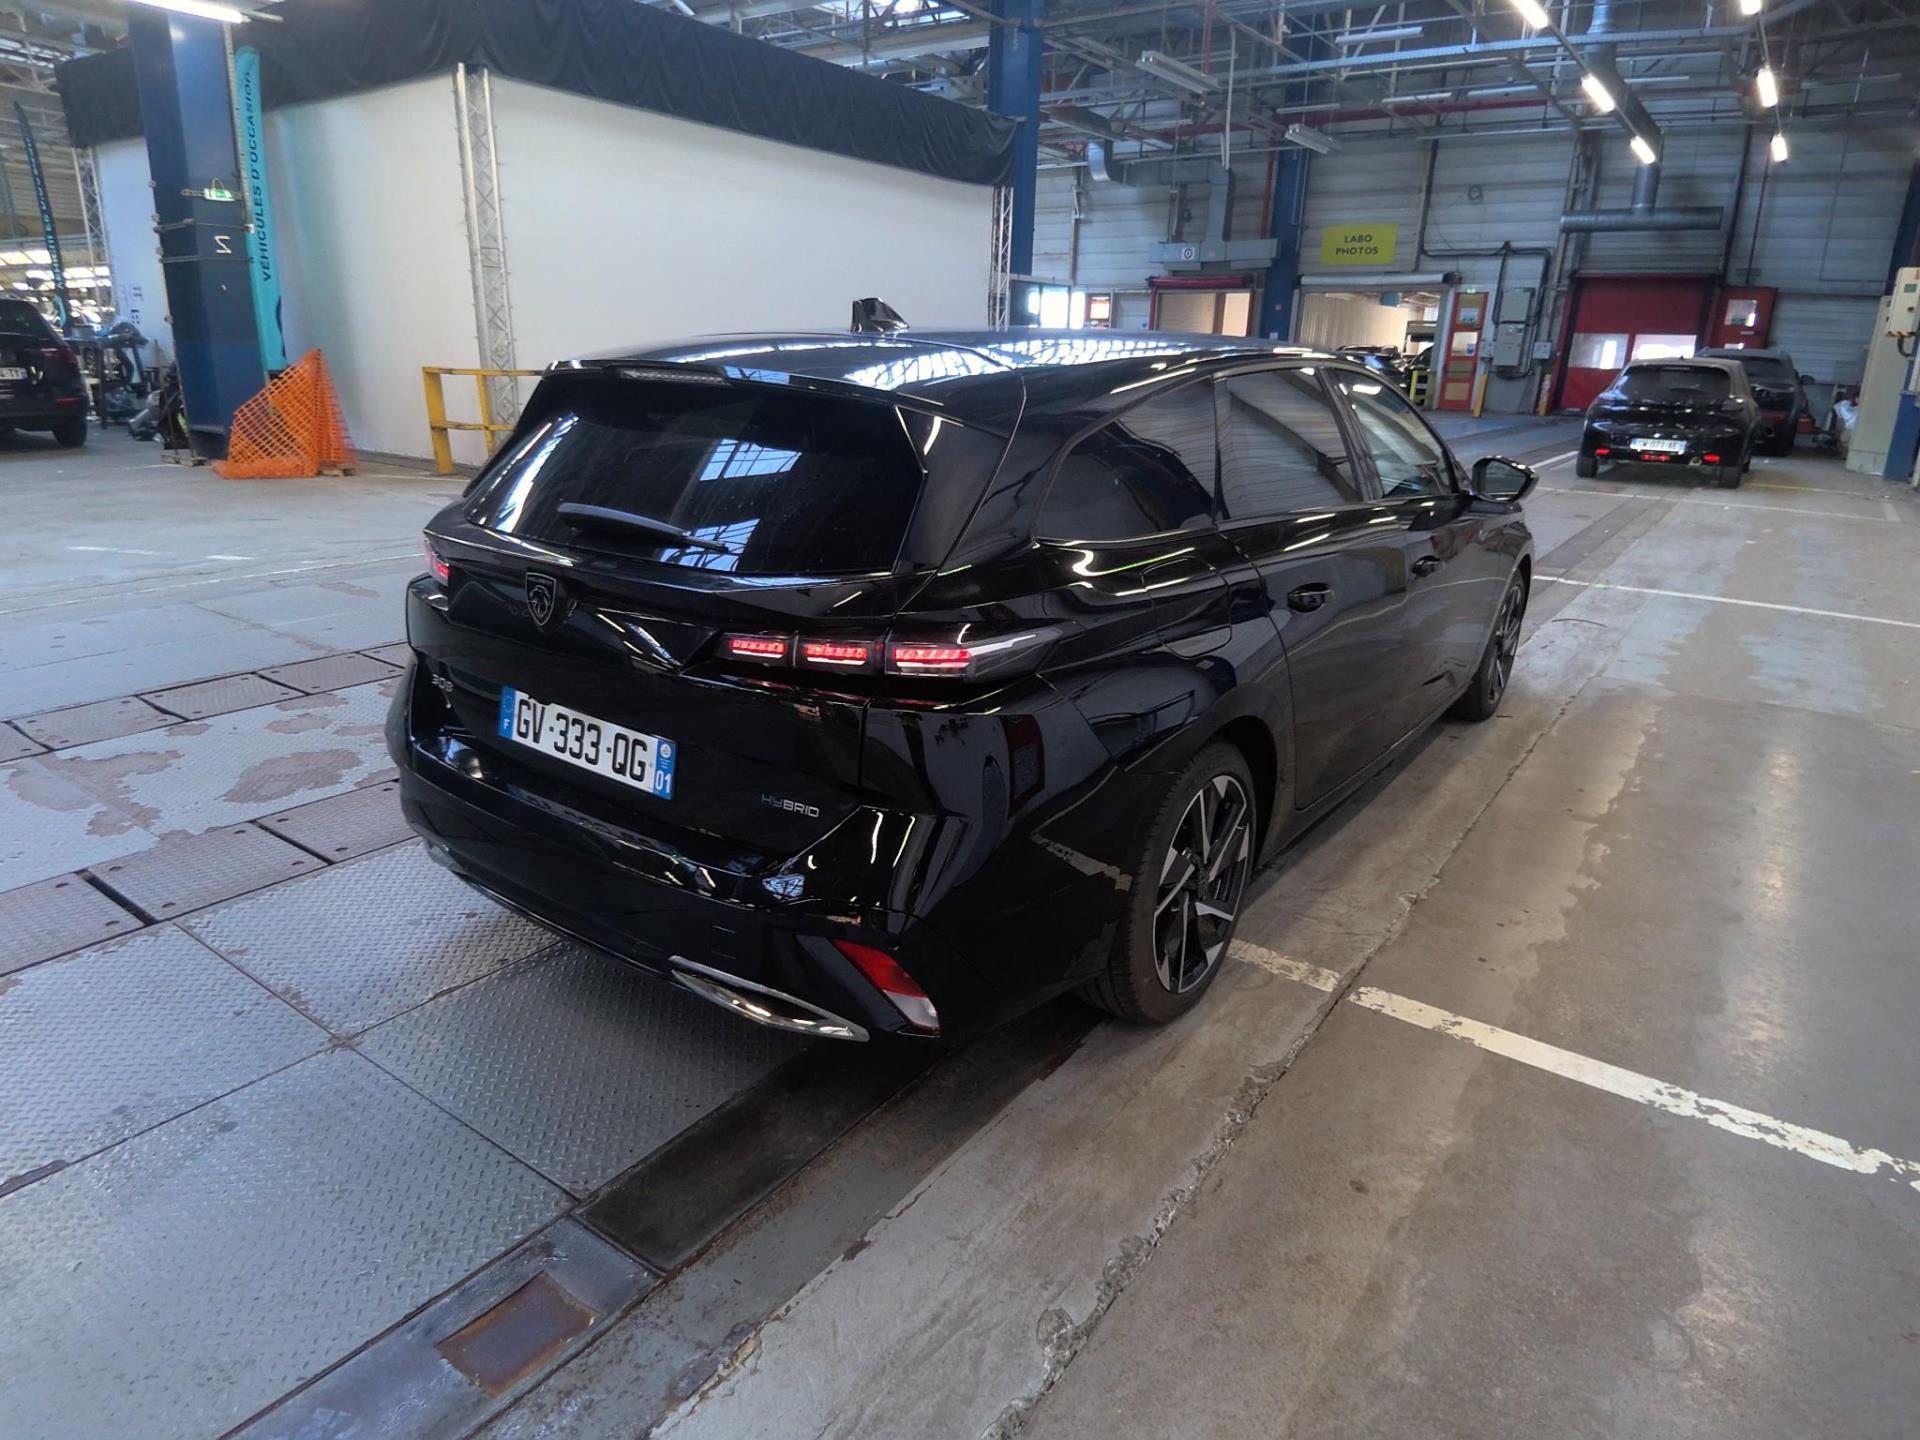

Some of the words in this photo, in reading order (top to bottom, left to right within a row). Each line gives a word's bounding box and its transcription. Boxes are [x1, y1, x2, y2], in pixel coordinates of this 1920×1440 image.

[1344, 234, 1373, 243] LABO
[1335, 246, 1378, 256] PHOTOS
[432, 674, 453, 692] 308
[503, 718, 511, 730] F
[655, 769, 672, 794] 01
[761, 793, 820, 819] HYBRID
